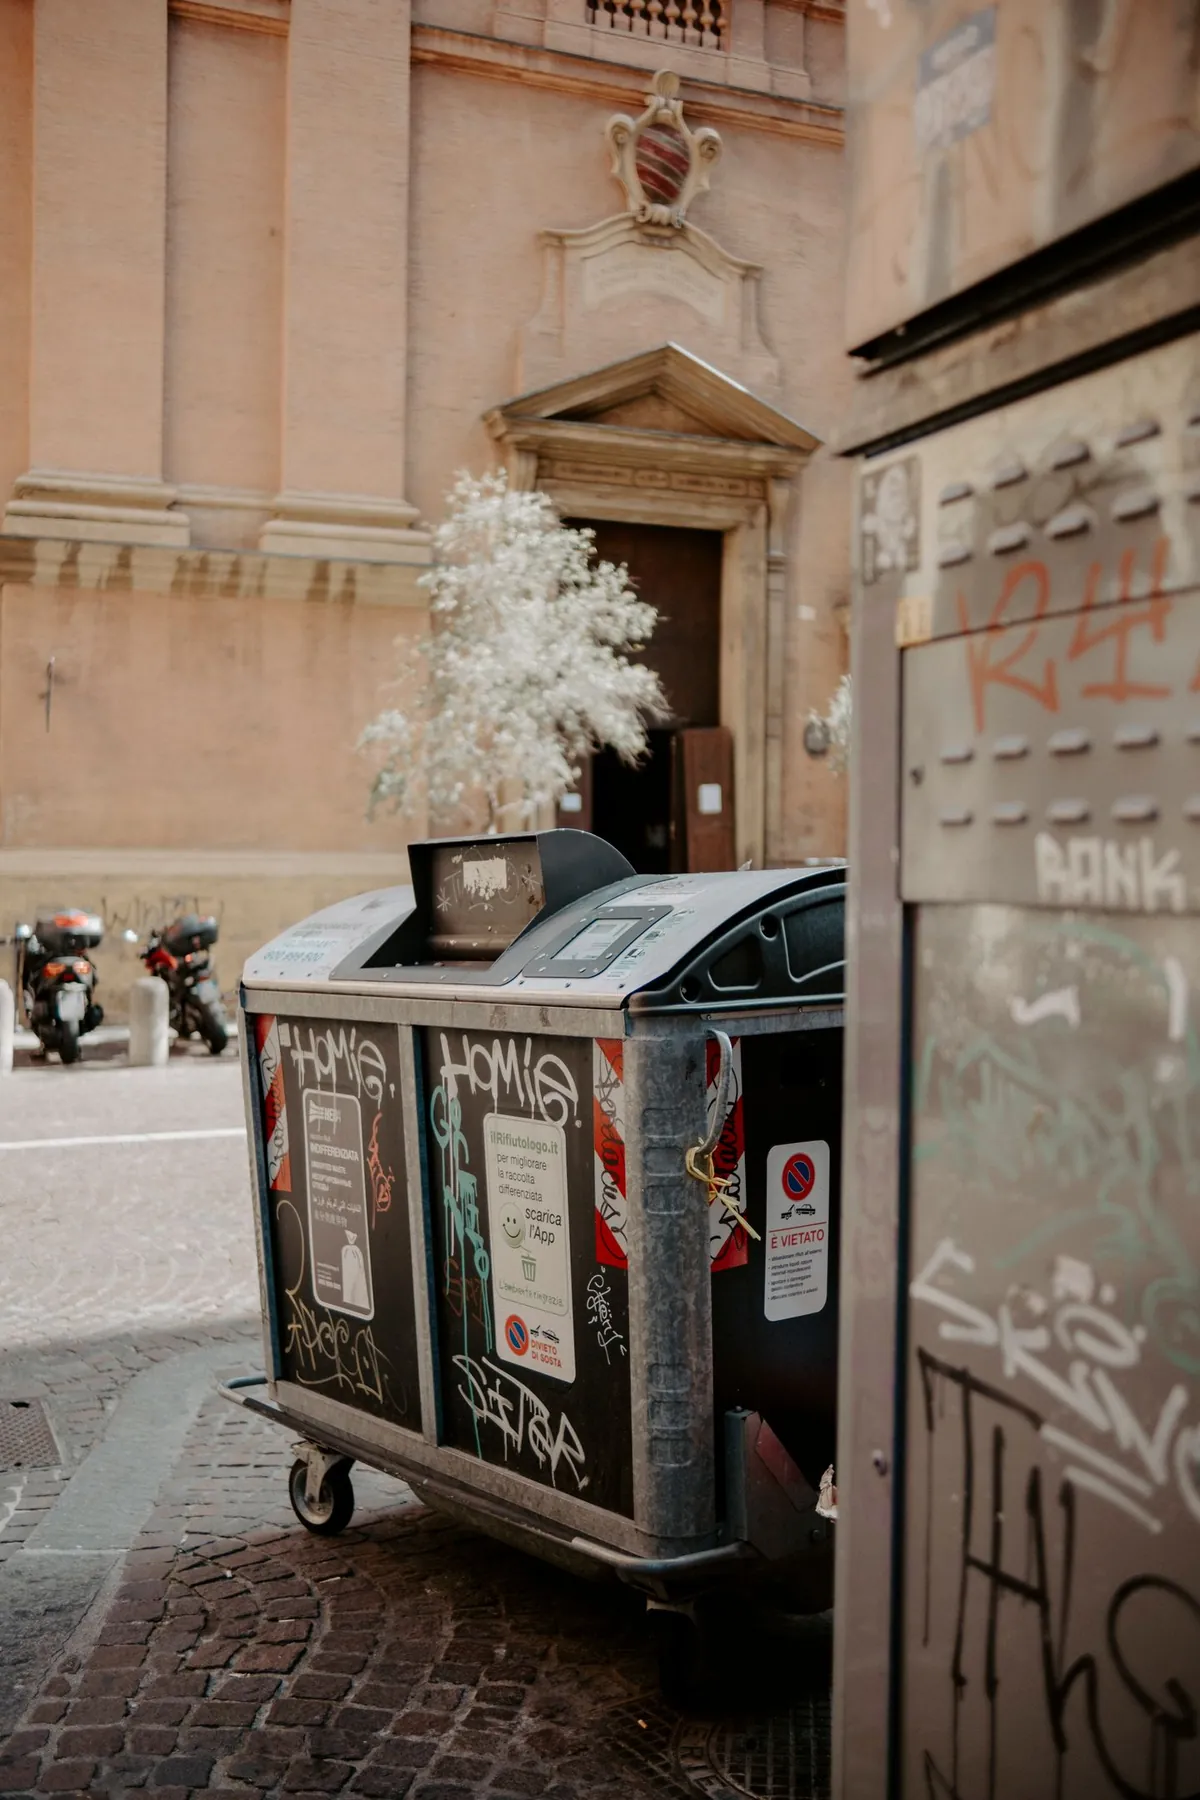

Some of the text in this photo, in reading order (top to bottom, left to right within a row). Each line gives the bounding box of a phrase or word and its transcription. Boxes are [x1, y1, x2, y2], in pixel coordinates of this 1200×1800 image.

[490, 1131, 558, 1155] ilRifiutologo.it
[497, 1153, 547, 1170] per migliorare
[497, 1167, 535, 1185] la raccolta
[499, 1184, 543, 1202] differenziata
[525, 1207, 562, 1227] scarica
[529, 1224, 555, 1246] l'App
[771, 1228, 825, 1249] È VIETATO
[531, 1340, 557, 1355] DIVIETO
[531, 1351, 562, 1368] DI SOSTA
